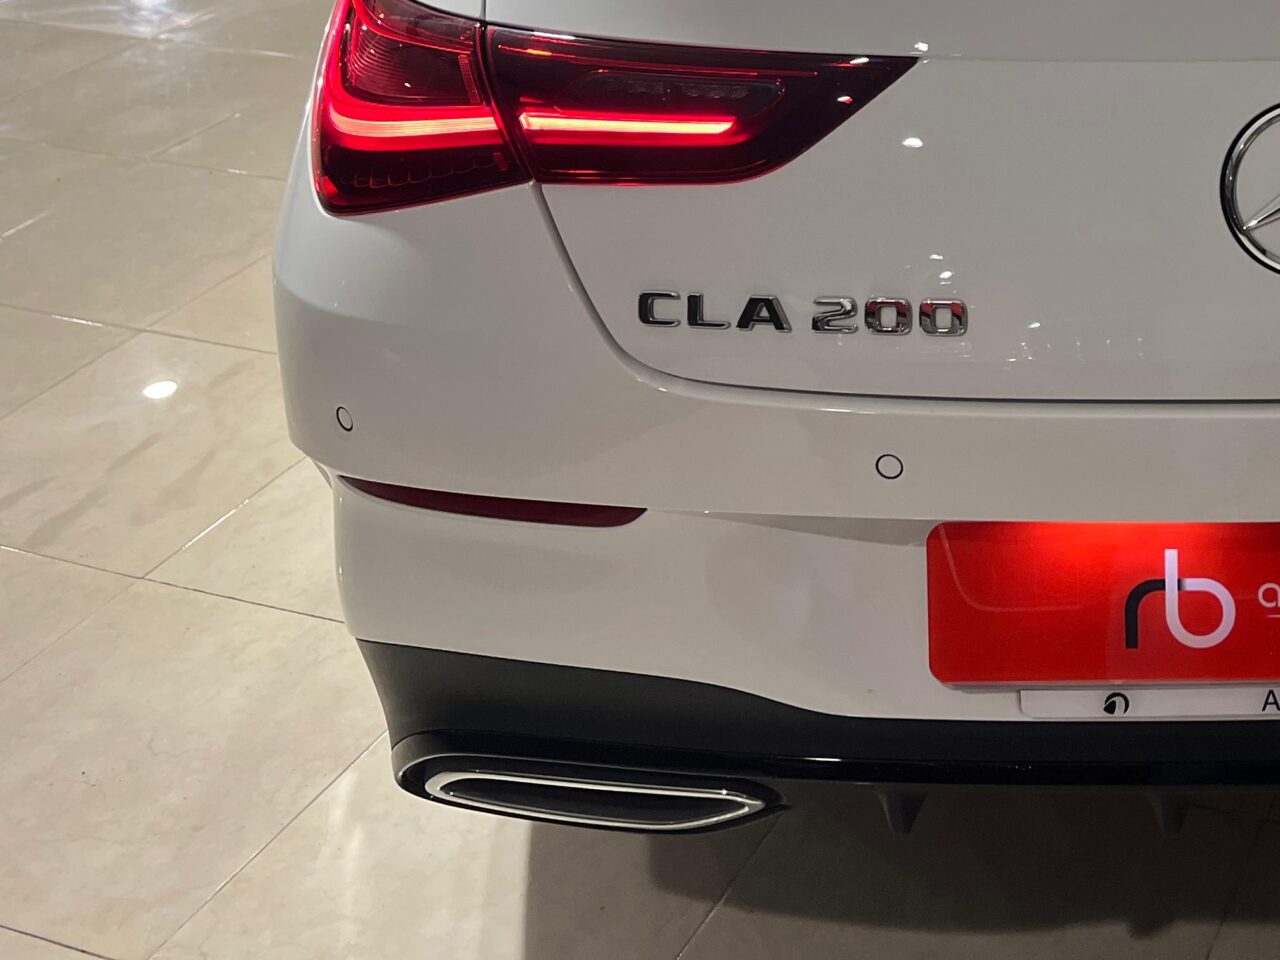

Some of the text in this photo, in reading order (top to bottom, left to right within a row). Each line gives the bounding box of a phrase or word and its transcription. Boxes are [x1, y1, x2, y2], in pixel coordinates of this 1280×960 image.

[638, 291, 969, 336] CLA 200
[1125, 549, 1236, 649] rb
